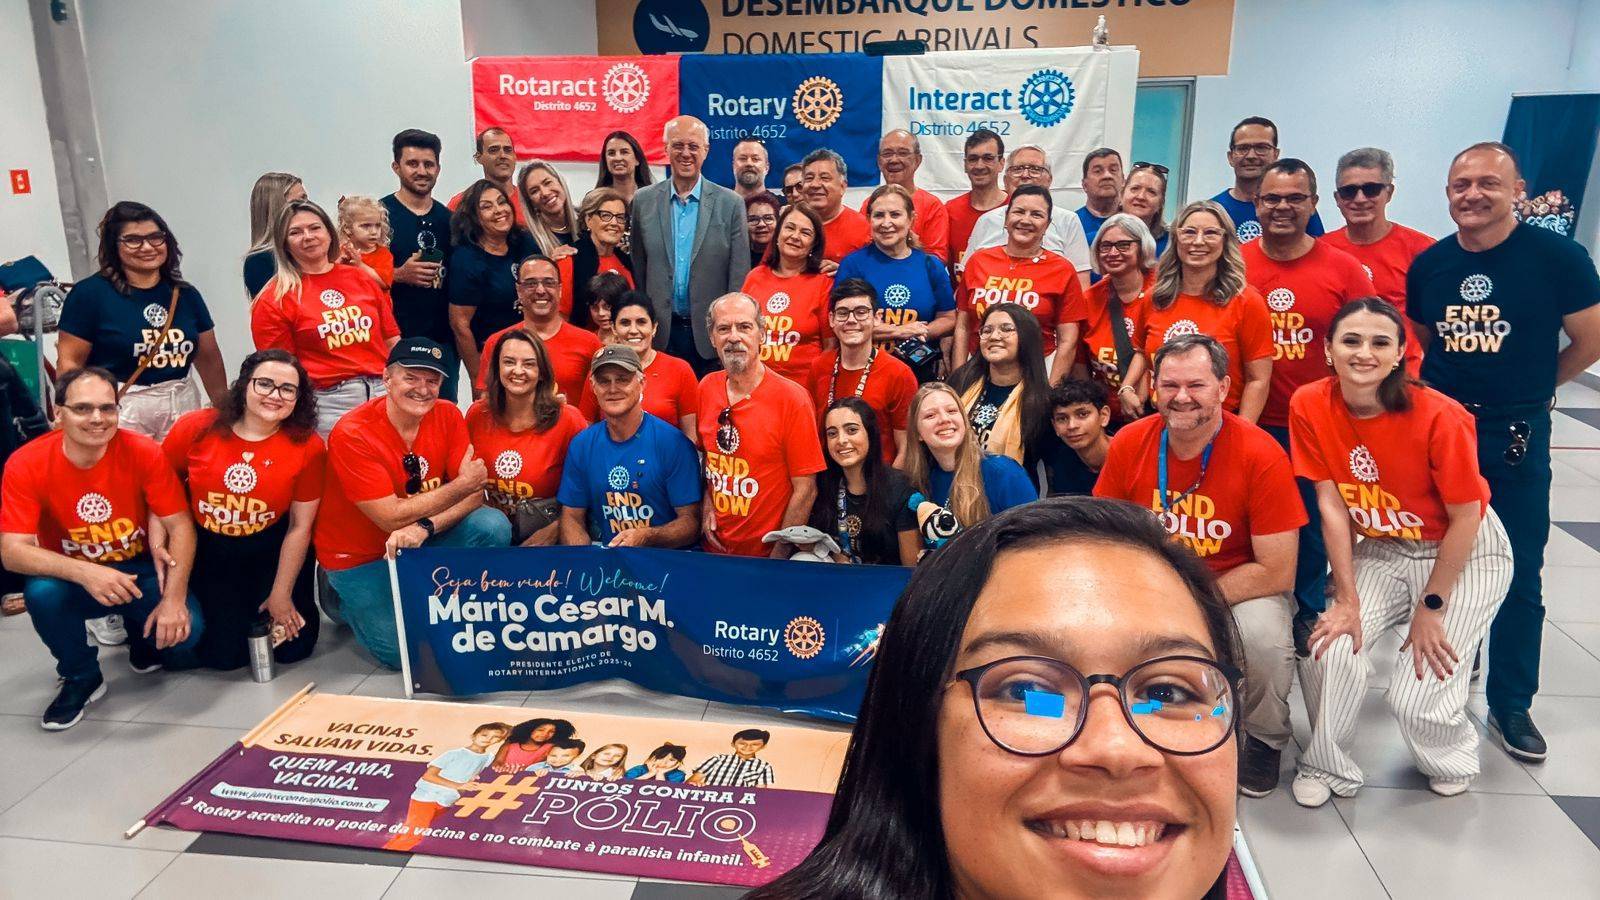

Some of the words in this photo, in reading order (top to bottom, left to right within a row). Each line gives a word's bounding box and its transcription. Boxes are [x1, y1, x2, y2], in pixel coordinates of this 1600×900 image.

[499, 74, 597, 97] Rotaract
[534, 101, 571, 112] Distrito
[573, 102, 597, 112] 4652
[708, 93, 787, 120] Rotary
[909, 87, 1012, 111] Interact
[710, 125, 748, 140] istrito
[751, 124, 787, 139] 4652
[910, 120, 964, 136] Distrito
[984, 276, 1034, 291] END
[972, 287, 1040, 309] POLIO
[321, 305, 362, 324] END
[764, 315, 794, 332] ND
[1270, 312, 1305, 329] ND
[1445, 305, 1500, 322] END
[317, 316, 373, 339] POLIO
[1436, 320, 1512, 338] POLIO
[326, 328, 371, 350] NOW
[1445, 335, 1505, 353] NOW
[760, 344, 793, 362] OW
[1272, 344, 1306, 361] OW
[707, 452, 750, 479] END
[207, 491, 268, 514] END
[606, 491, 642, 508] END
[1337, 482, 1402, 511] END
[602, 504, 654, 521] POLIO
[1348, 506, 1425, 532] OLIO
[68, 517, 135, 545] END
[203, 514, 268, 537] NOW
[1157, 511, 1232, 540] OLIO
[431, 566, 477, 598] Seja
[480, 569, 515, 593] bem
[579, 566, 669, 596] Welcome!
[428, 593, 529, 625] Mário
[534, 594, 633, 623] César
[638, 595, 674, 628] M.
[451, 623, 496, 653] de
[501, 624, 657, 653] Camargo
[715, 620, 780, 646] Rotary
[566, 653, 597, 666] ELEITO
[703, 644, 745, 659] Distrito
[748, 648, 779, 662] 4652
[489, 669, 523, 677] ROTARY
[525, 663, 596, 676] INTERNATIONAL
[327, 722, 418, 738] VACINAS
[274, 733, 362, 750] SALVAM
[365, 740, 434, 756] VIDAS.
[268, 755, 339, 772] QUEM
[341, 761, 395, 779] AMA,
[273, 771, 359, 791] VACINA.
[545, 777, 633, 796] JUNTOS
[638, 782, 734, 804] CONTRA
[739, 792, 756, 805] A
[522, 791, 757, 842] PÓLIO
[193, 801, 247, 820] Rotary
[247, 809, 310, 826] acredita
[313, 815, 335, 828] no
[337, 817, 387, 834] poder
[389, 820, 409, 835] da
[413, 826, 464, 841] vacina
[469, 831, 480, 842] e
[485, 832, 505, 844] no
[508, 833, 581, 852] combate
[584, 837, 595, 853] à
[597, 841, 673, 861] paralisia
[677, 847, 744, 867] infantil.
